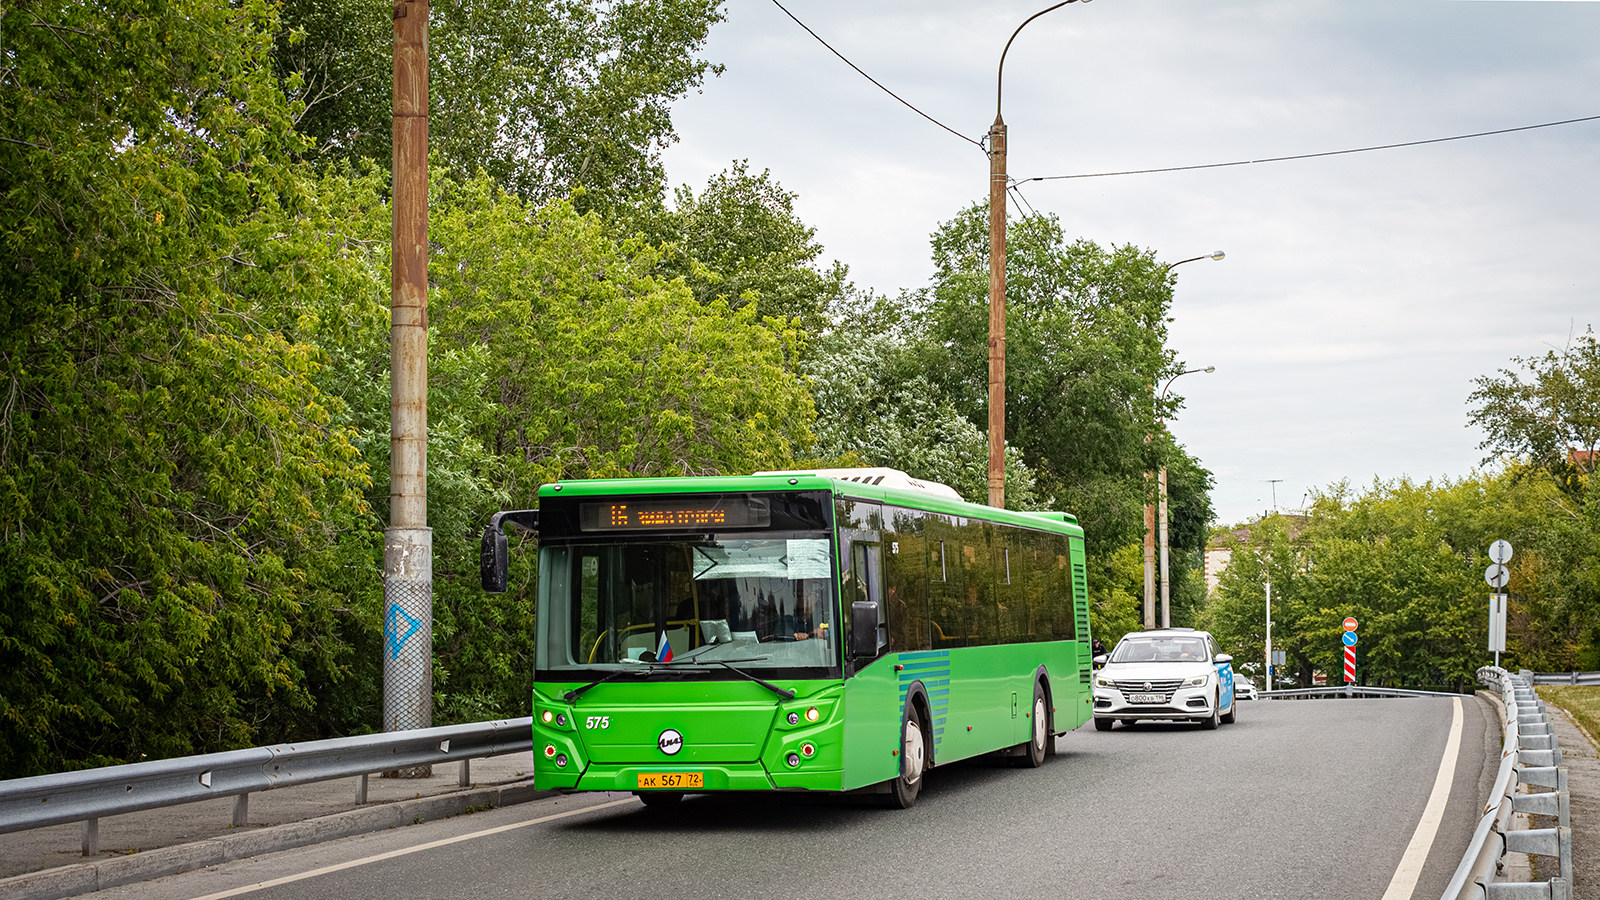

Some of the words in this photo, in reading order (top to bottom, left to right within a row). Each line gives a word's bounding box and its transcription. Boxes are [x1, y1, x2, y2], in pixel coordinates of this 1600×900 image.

[585, 715, 610, 730] 575
[643, 777, 656, 786] АК
[661, 774, 682, 786] 567
[688, 774, 699, 783] 72
